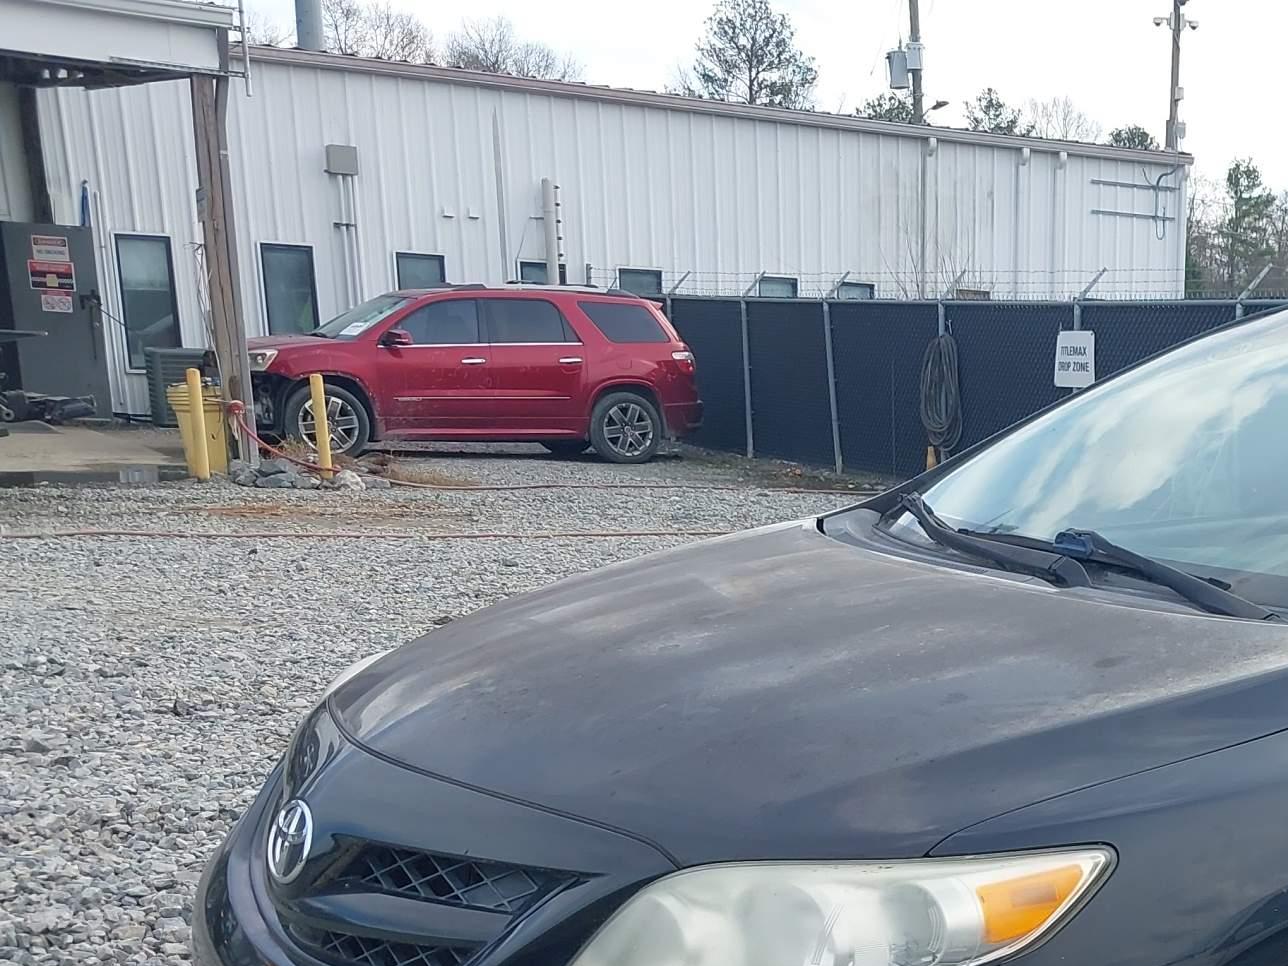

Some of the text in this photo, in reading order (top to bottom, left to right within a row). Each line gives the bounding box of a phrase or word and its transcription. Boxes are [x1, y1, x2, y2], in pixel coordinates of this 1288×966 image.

[1060, 345, 1087, 357] TITLEMAX
[1058, 361, 1090, 372] DROP ZONE
